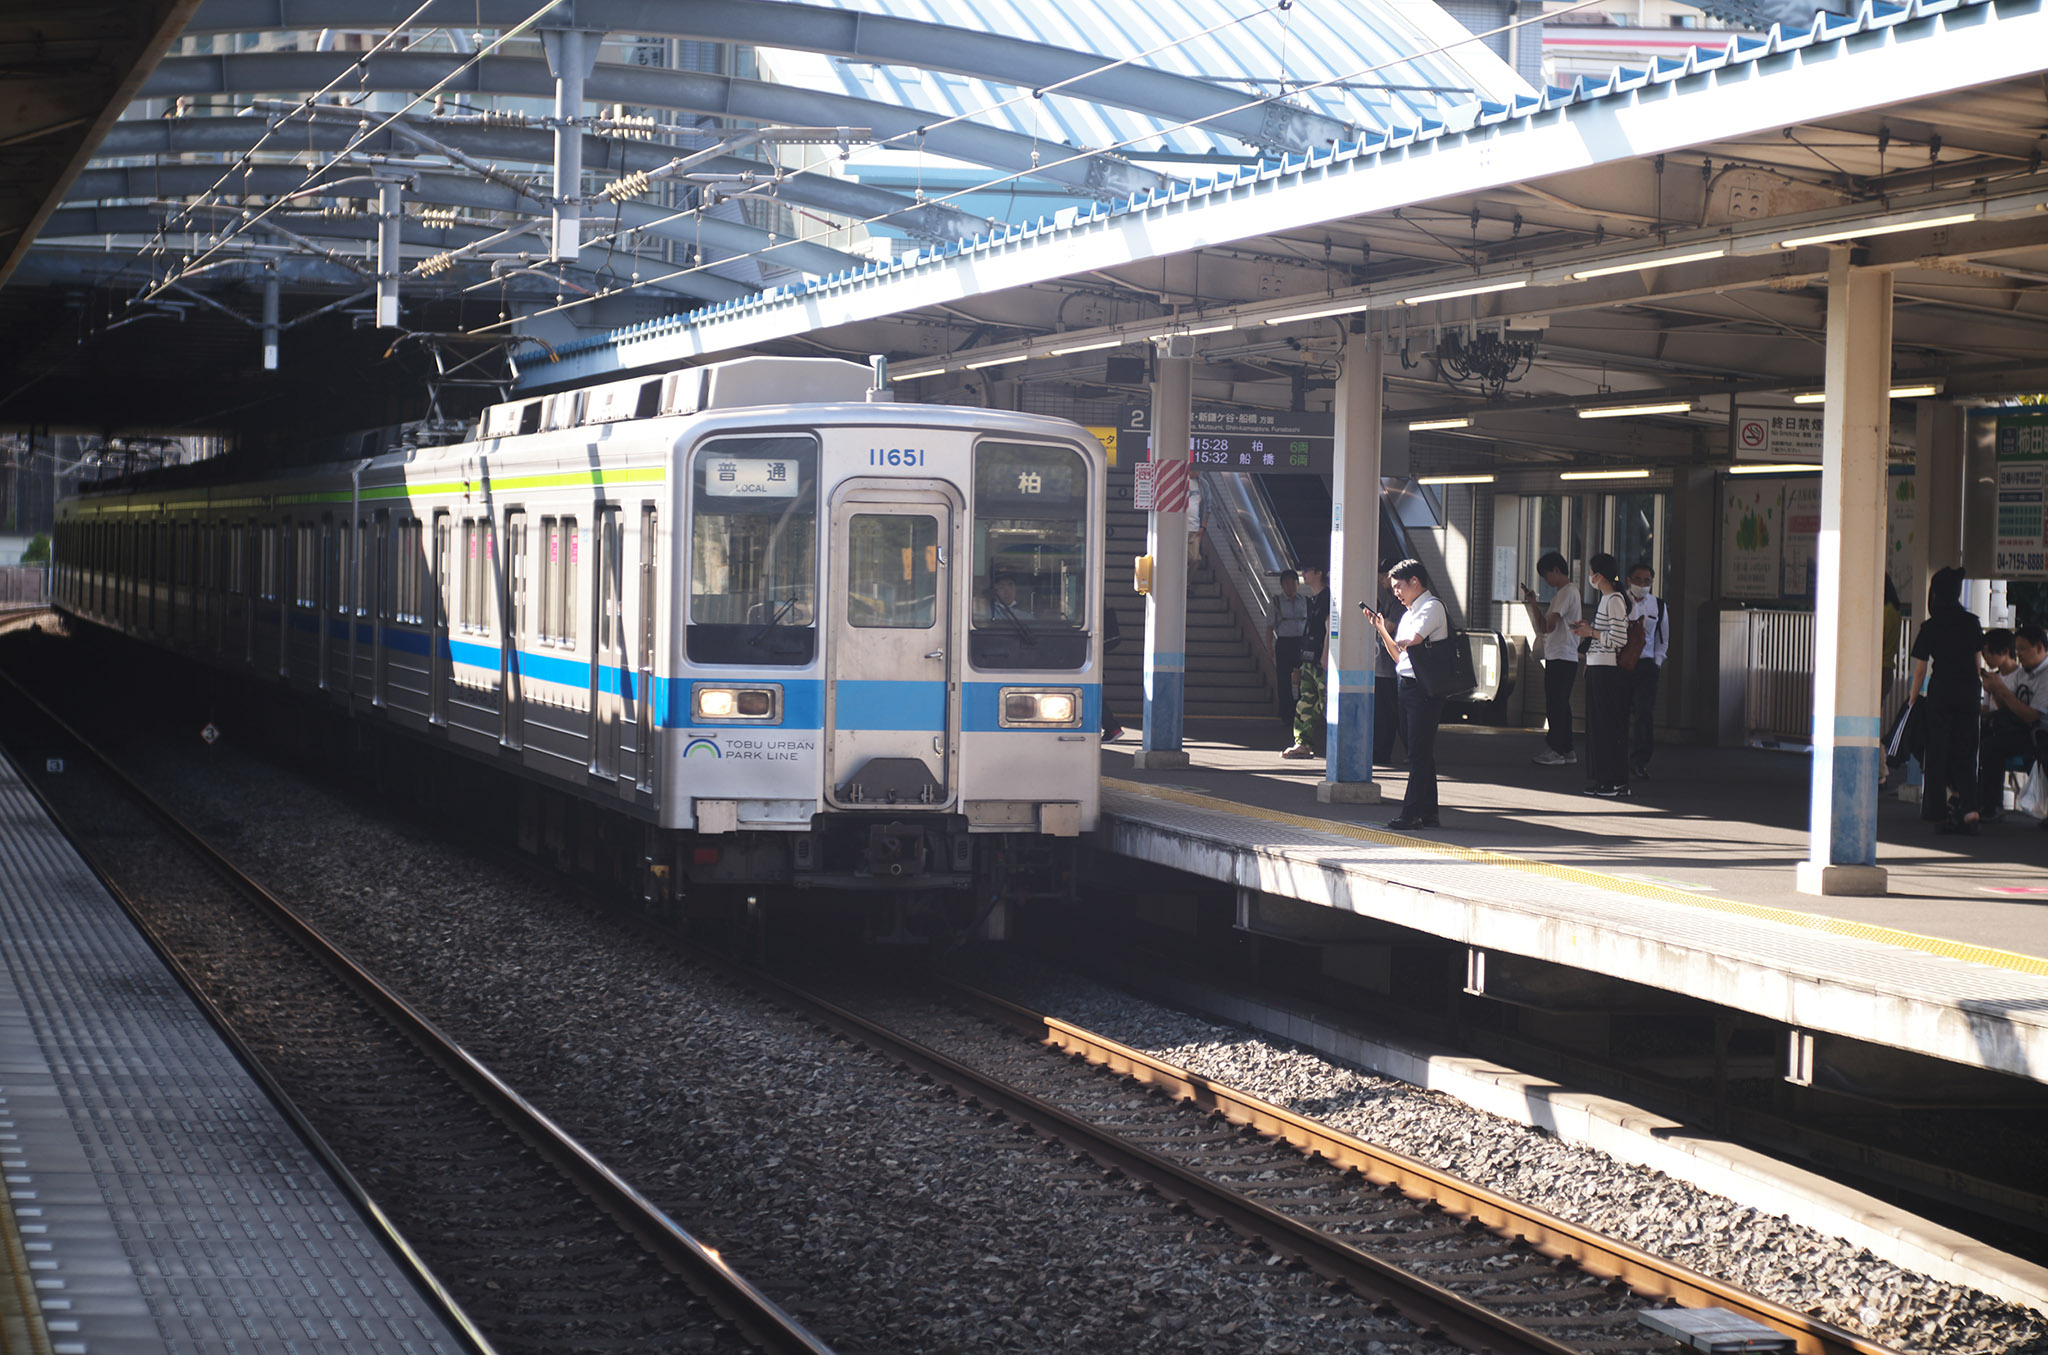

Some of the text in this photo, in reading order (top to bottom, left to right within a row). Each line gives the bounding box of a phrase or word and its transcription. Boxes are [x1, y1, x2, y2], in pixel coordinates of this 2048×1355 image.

[1131, 410, 1144, 428] 2
[1772, 416, 1824, 430] 終日禁煙
[1195, 438, 1309, 454] 15:28 柏 6両
[869, 448, 924, 466] 11651
[1194, 451, 1309, 467] 15:32 船橋 6両
[717, 462, 787, 482] 普通
[735, 483, 767, 492] LOCAL
[1018, 471, 1041, 494] 柏
[1997, 551, 2045, 570] 04-7159-8888
[725, 740, 815, 750] TOBU URBAN
[725, 751, 799, 761] PARK LINE
